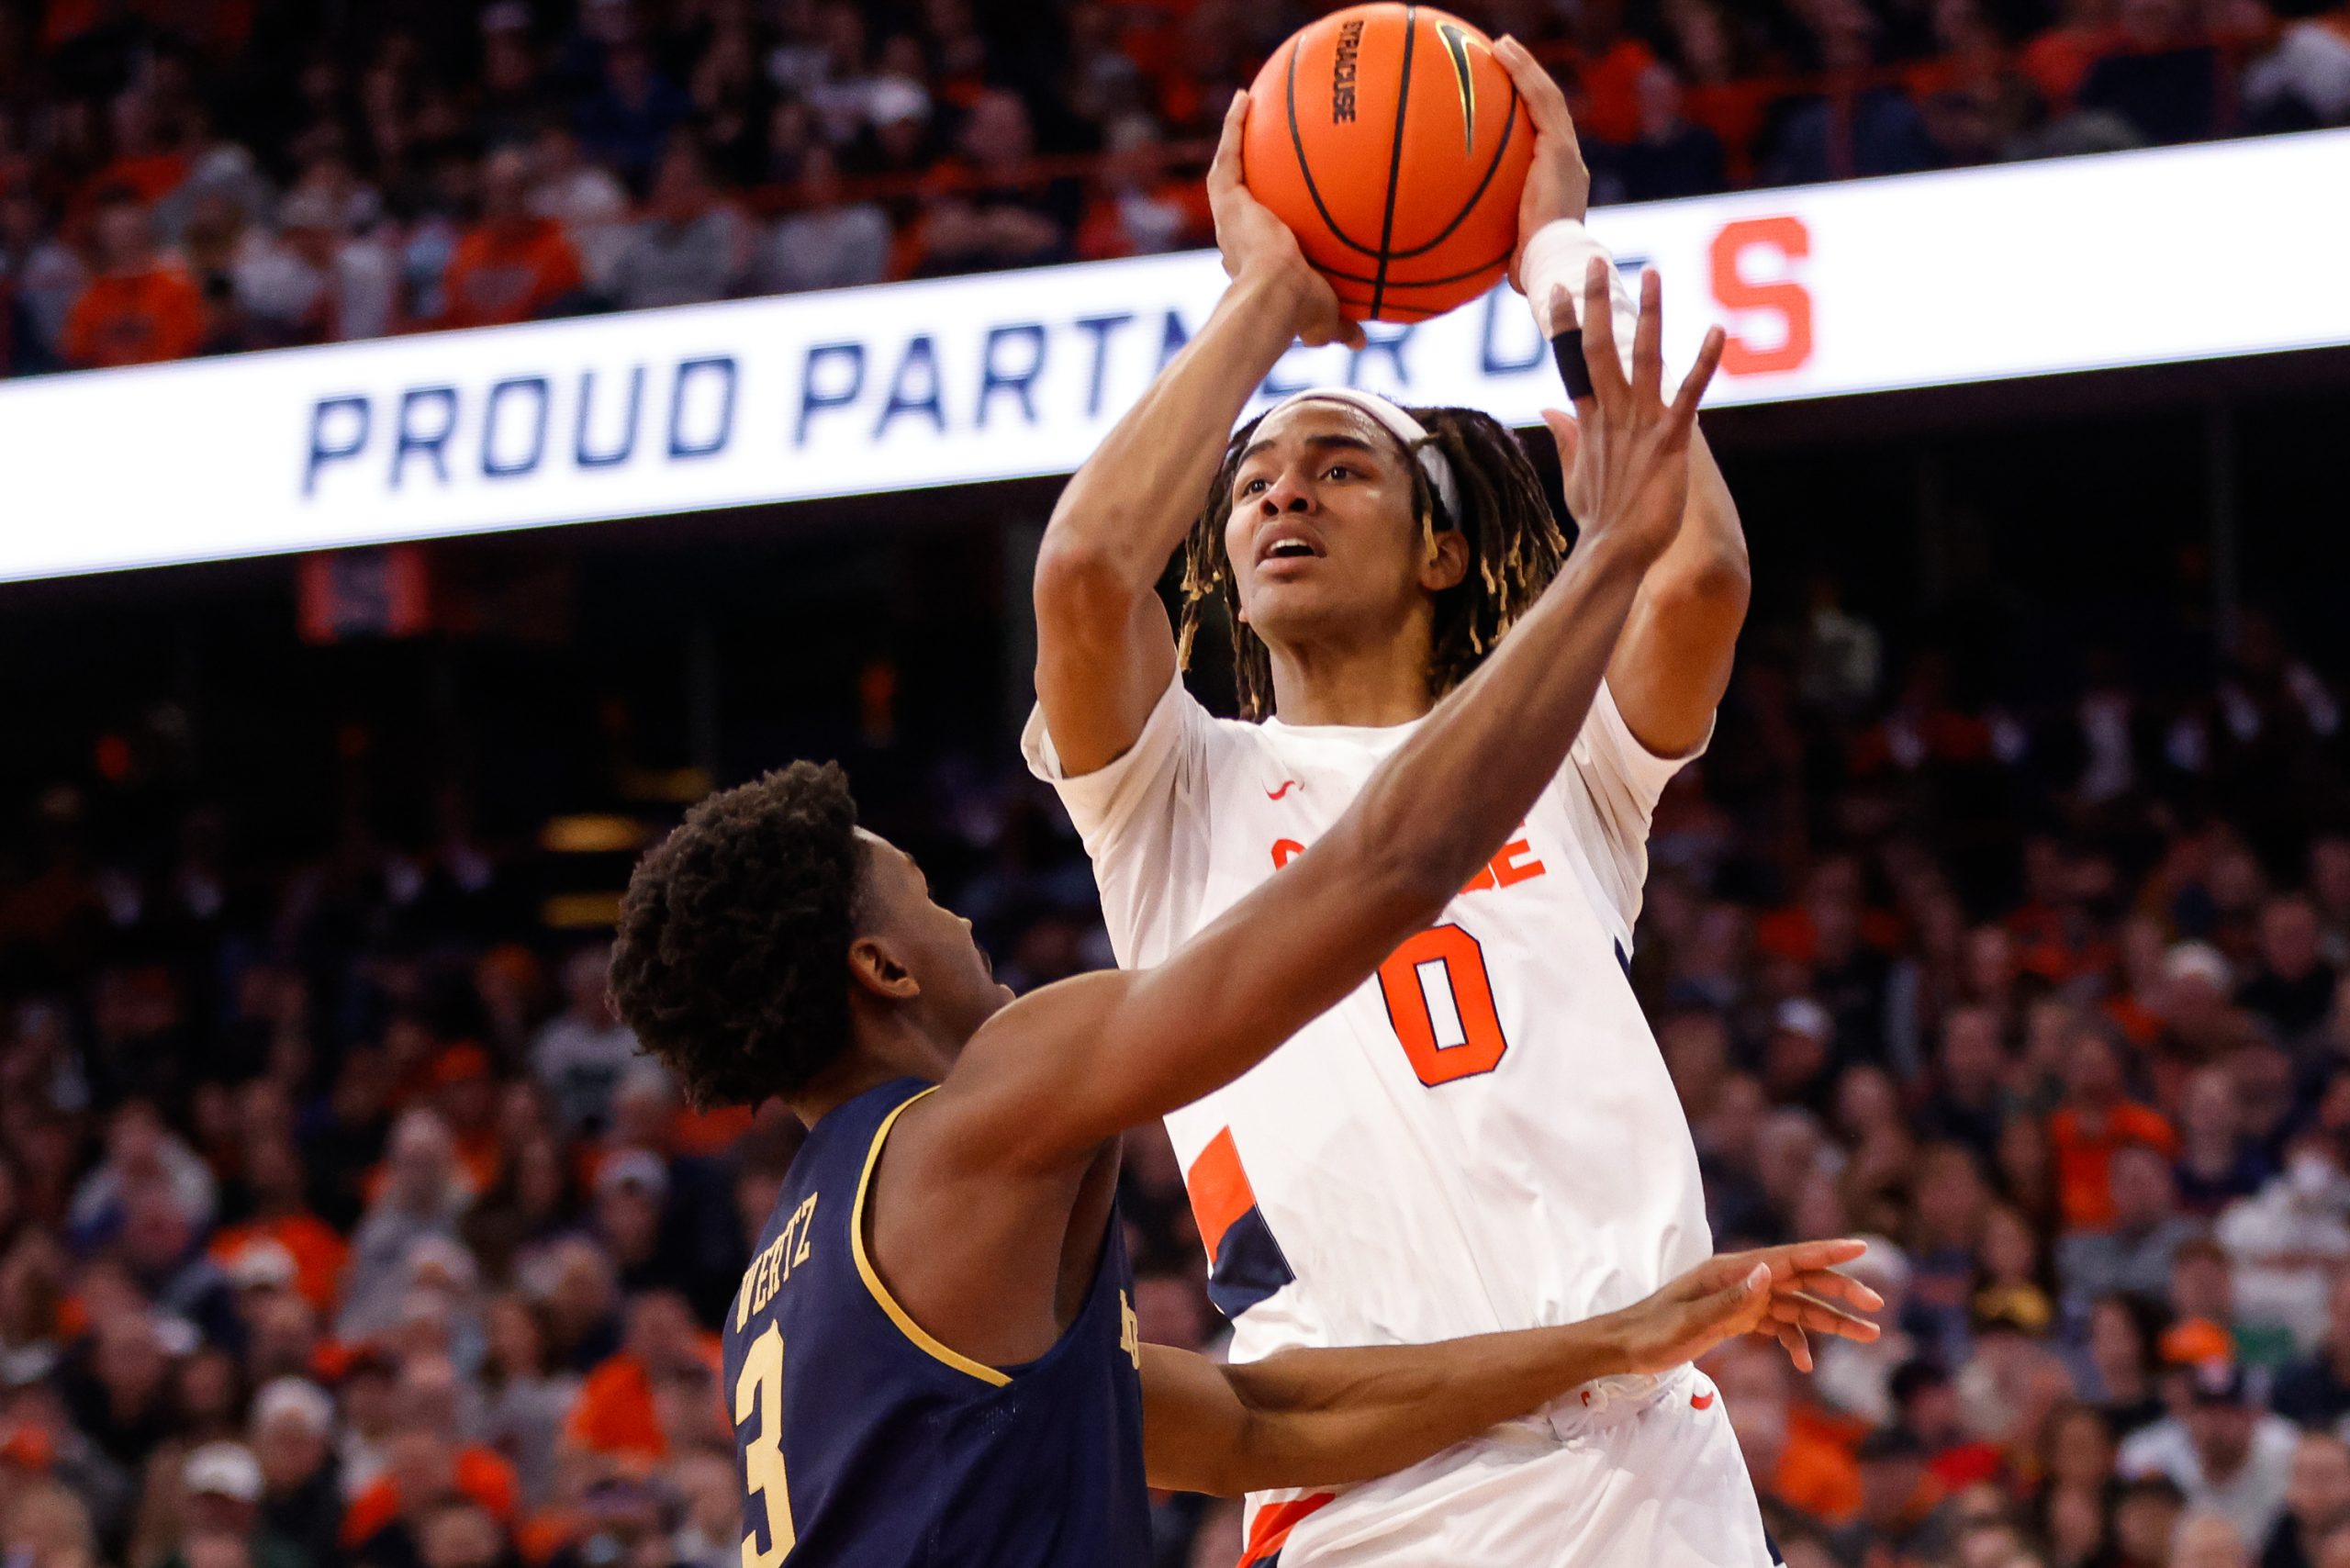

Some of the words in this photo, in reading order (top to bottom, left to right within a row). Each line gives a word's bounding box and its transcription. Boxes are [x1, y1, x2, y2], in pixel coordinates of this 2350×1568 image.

[1333, 20, 1364, 124] SYRACUSE
[301, 355, 738, 496] PROUD
[1709, 215, 1813, 376] S
[1376, 922, 1508, 1089] 0
[736, 1191, 819, 1334] WERTZ
[735, 1318, 797, 1568] 3
